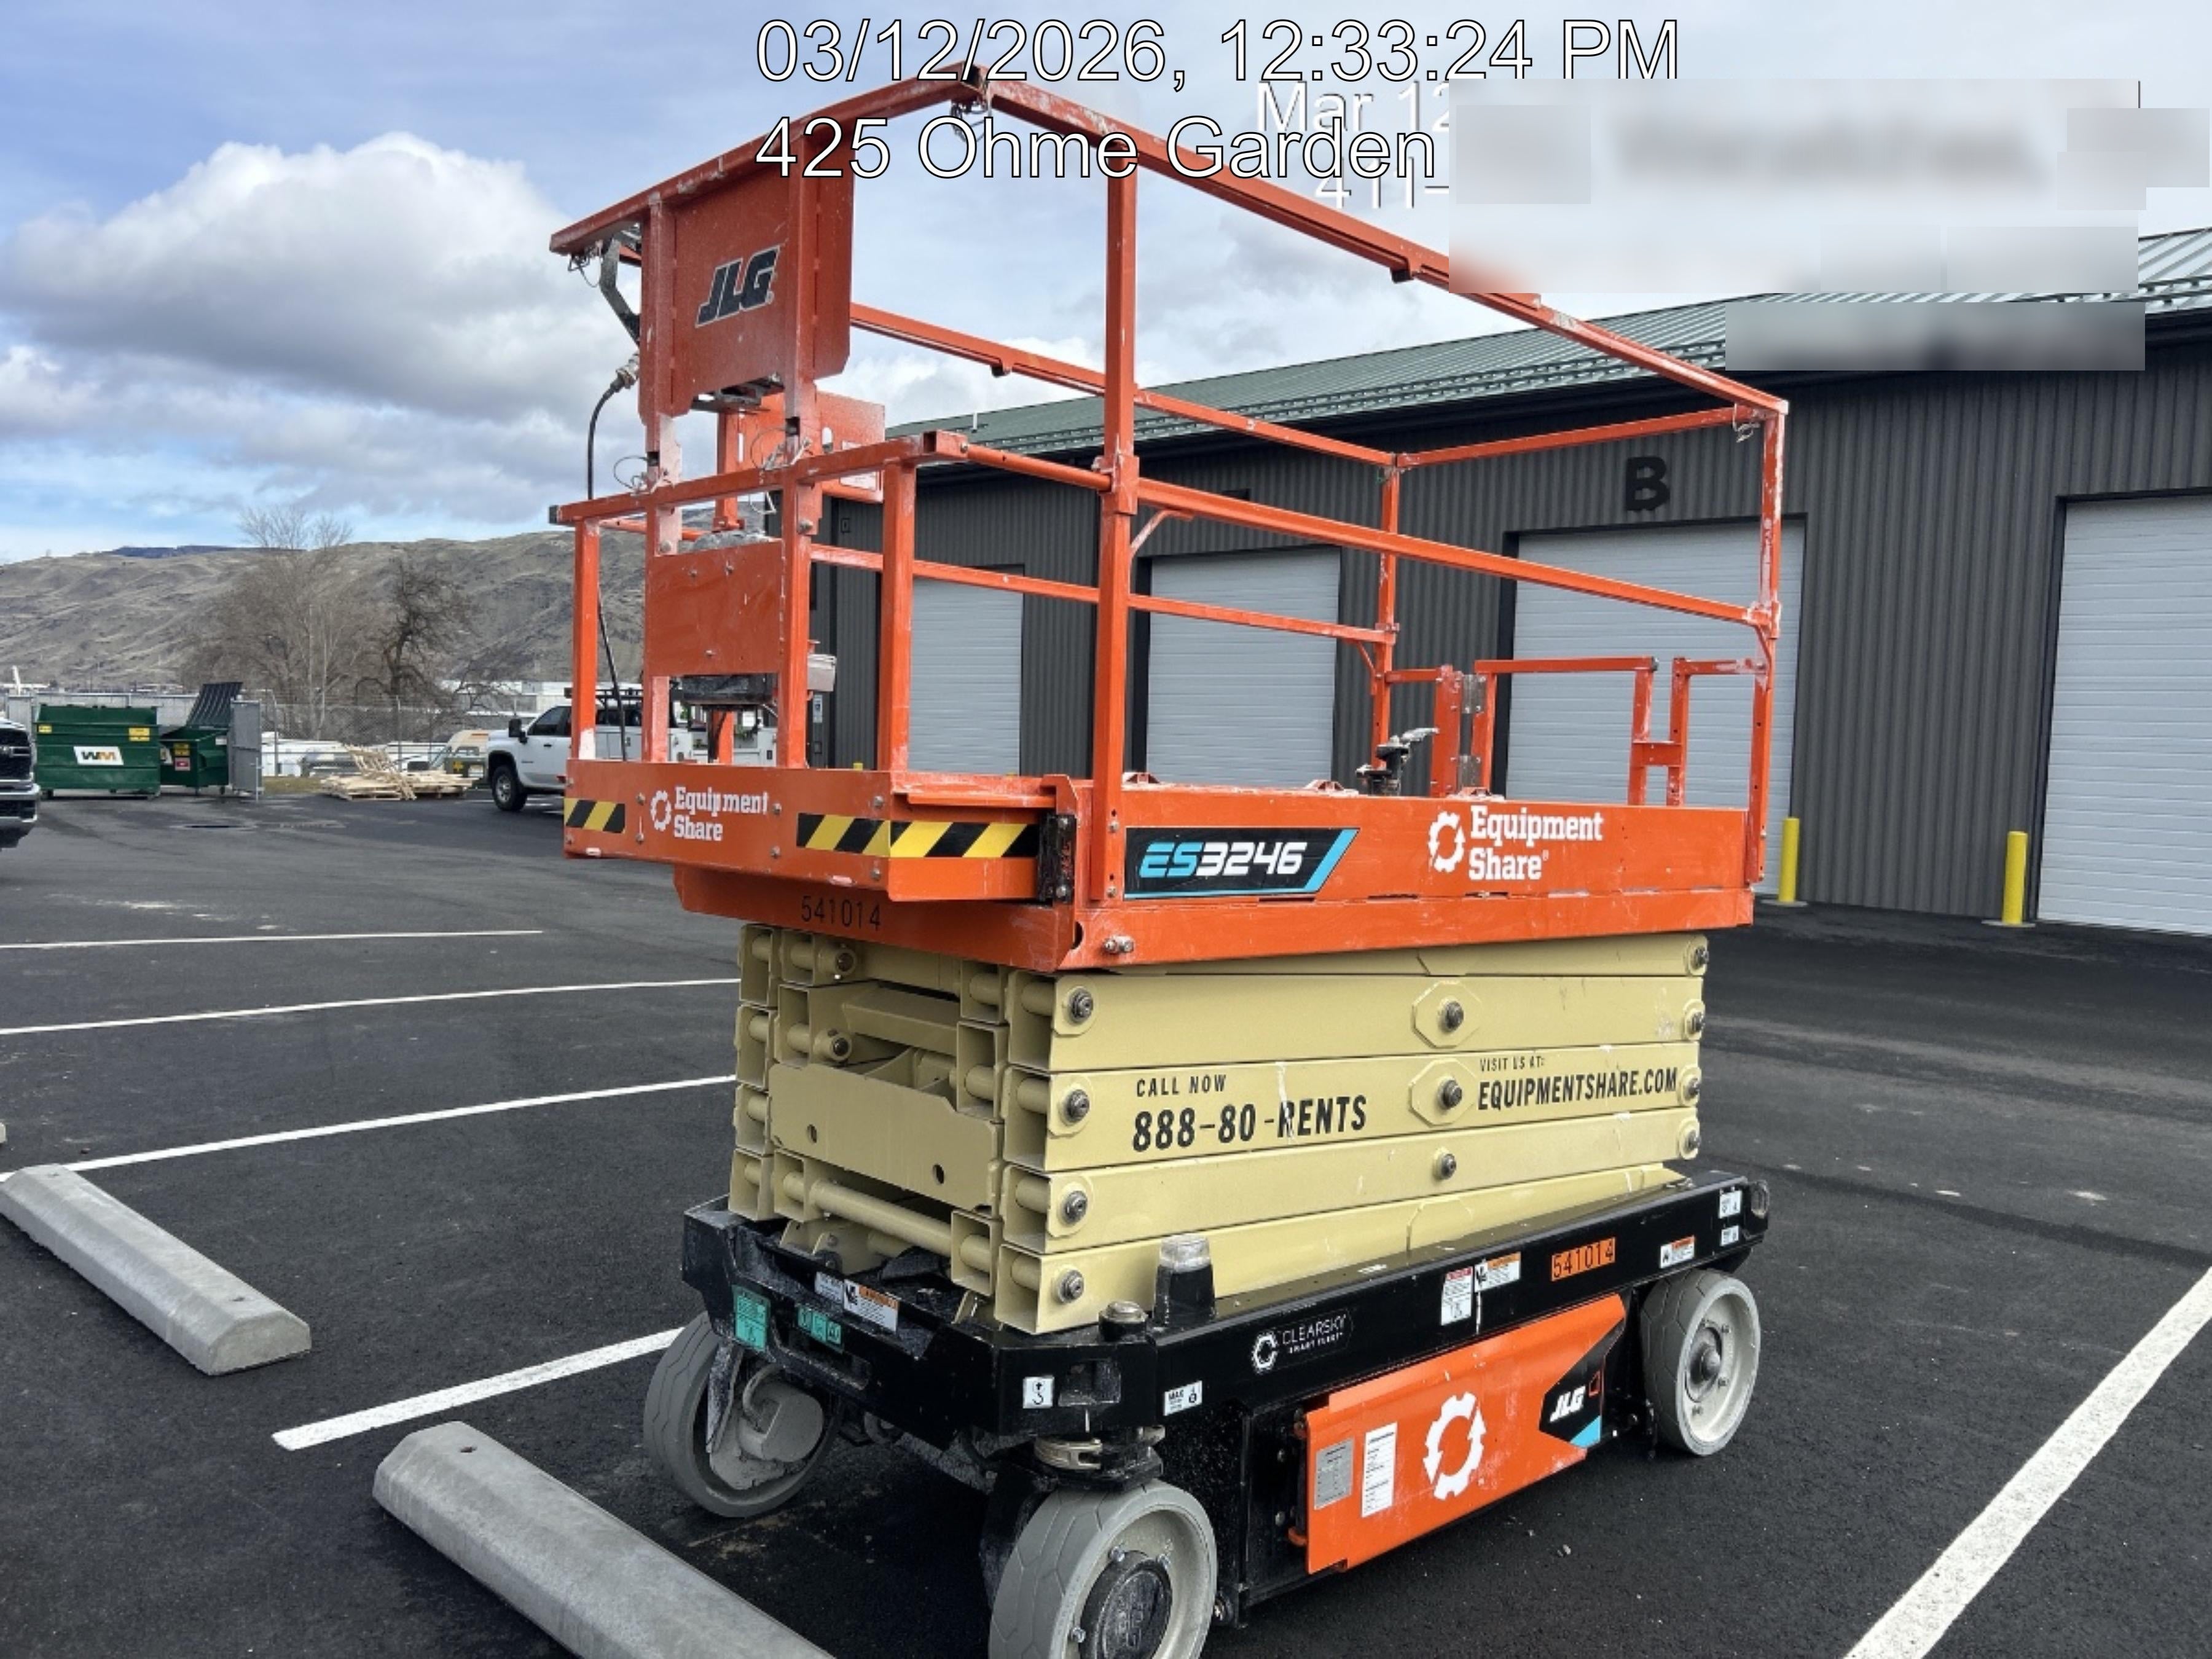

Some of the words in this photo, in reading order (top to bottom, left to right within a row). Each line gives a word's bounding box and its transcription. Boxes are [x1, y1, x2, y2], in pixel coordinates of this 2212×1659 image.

[695, 246, 780, 328] JLG
[1625, 456, 1670, 511] B
[80, 750, 117, 761] WM
[674, 786, 768, 817] Equipment
[674, 814, 723, 842] Share
[1470, 805, 1604, 847] Equipment
[1139, 841, 1308, 878] ES3246
[801, 895, 881, 931] 541014
[1479, 1057, 1509, 1072] VISIT
[1136, 1077, 1180, 1097] CALL
[1189, 1074, 1226, 1094] NOW
[1477, 1066, 1678, 1111] EQUIPMENTSHARE.COM
[1553, 1240, 1614, 1278] 541014
[1550, 1384, 1586, 1422] JLG
